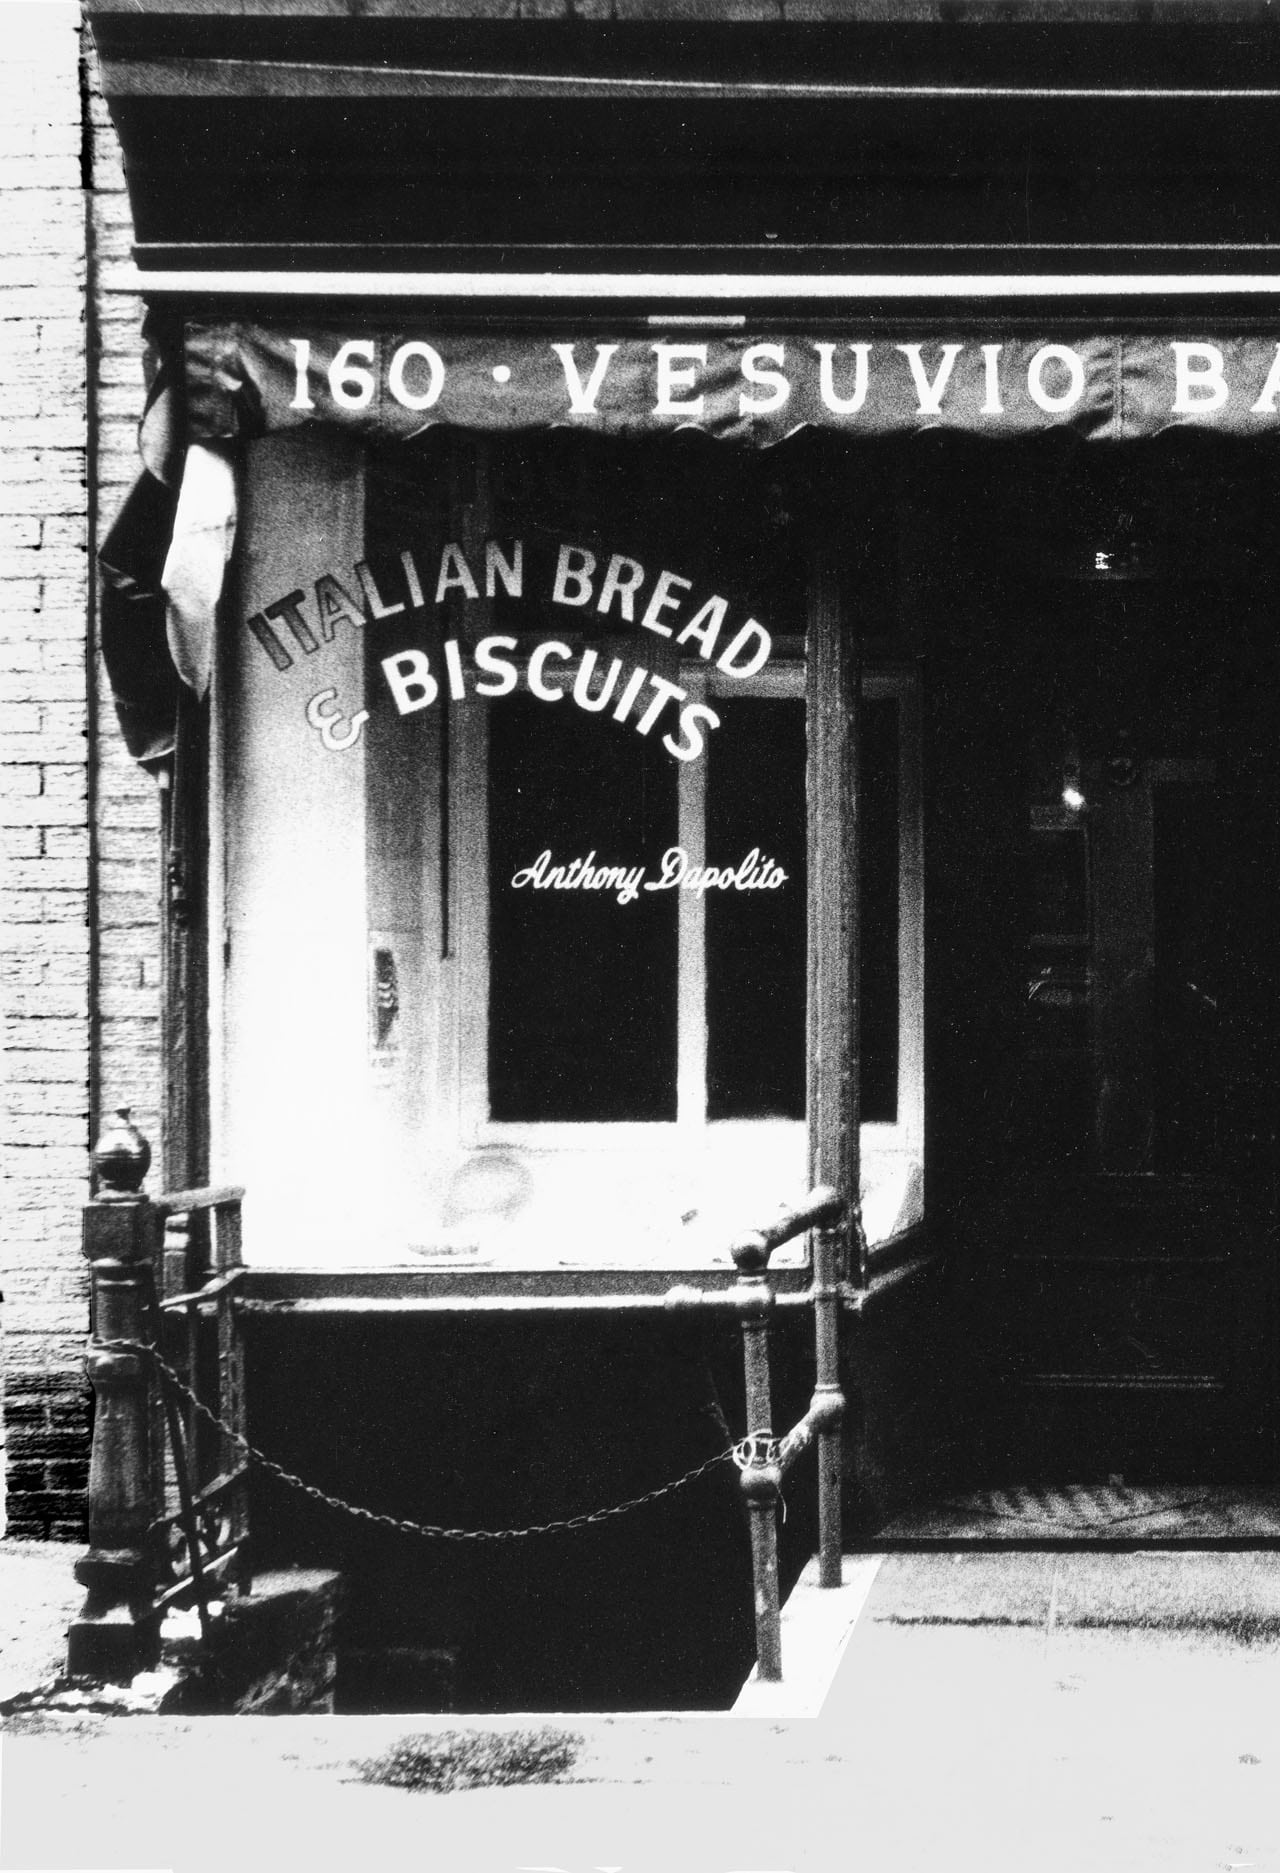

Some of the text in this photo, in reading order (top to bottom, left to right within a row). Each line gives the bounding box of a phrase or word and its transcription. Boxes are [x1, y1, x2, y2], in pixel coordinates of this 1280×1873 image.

[288, 338, 445, 410] 160
[551, 341, 1086, 416] VESUVIO
[247, 540, 772, 679] ITALIAN BREAD
[381, 635, 721, 761] BISCUITS
[511, 846, 789, 904] Anthony Dapolito
